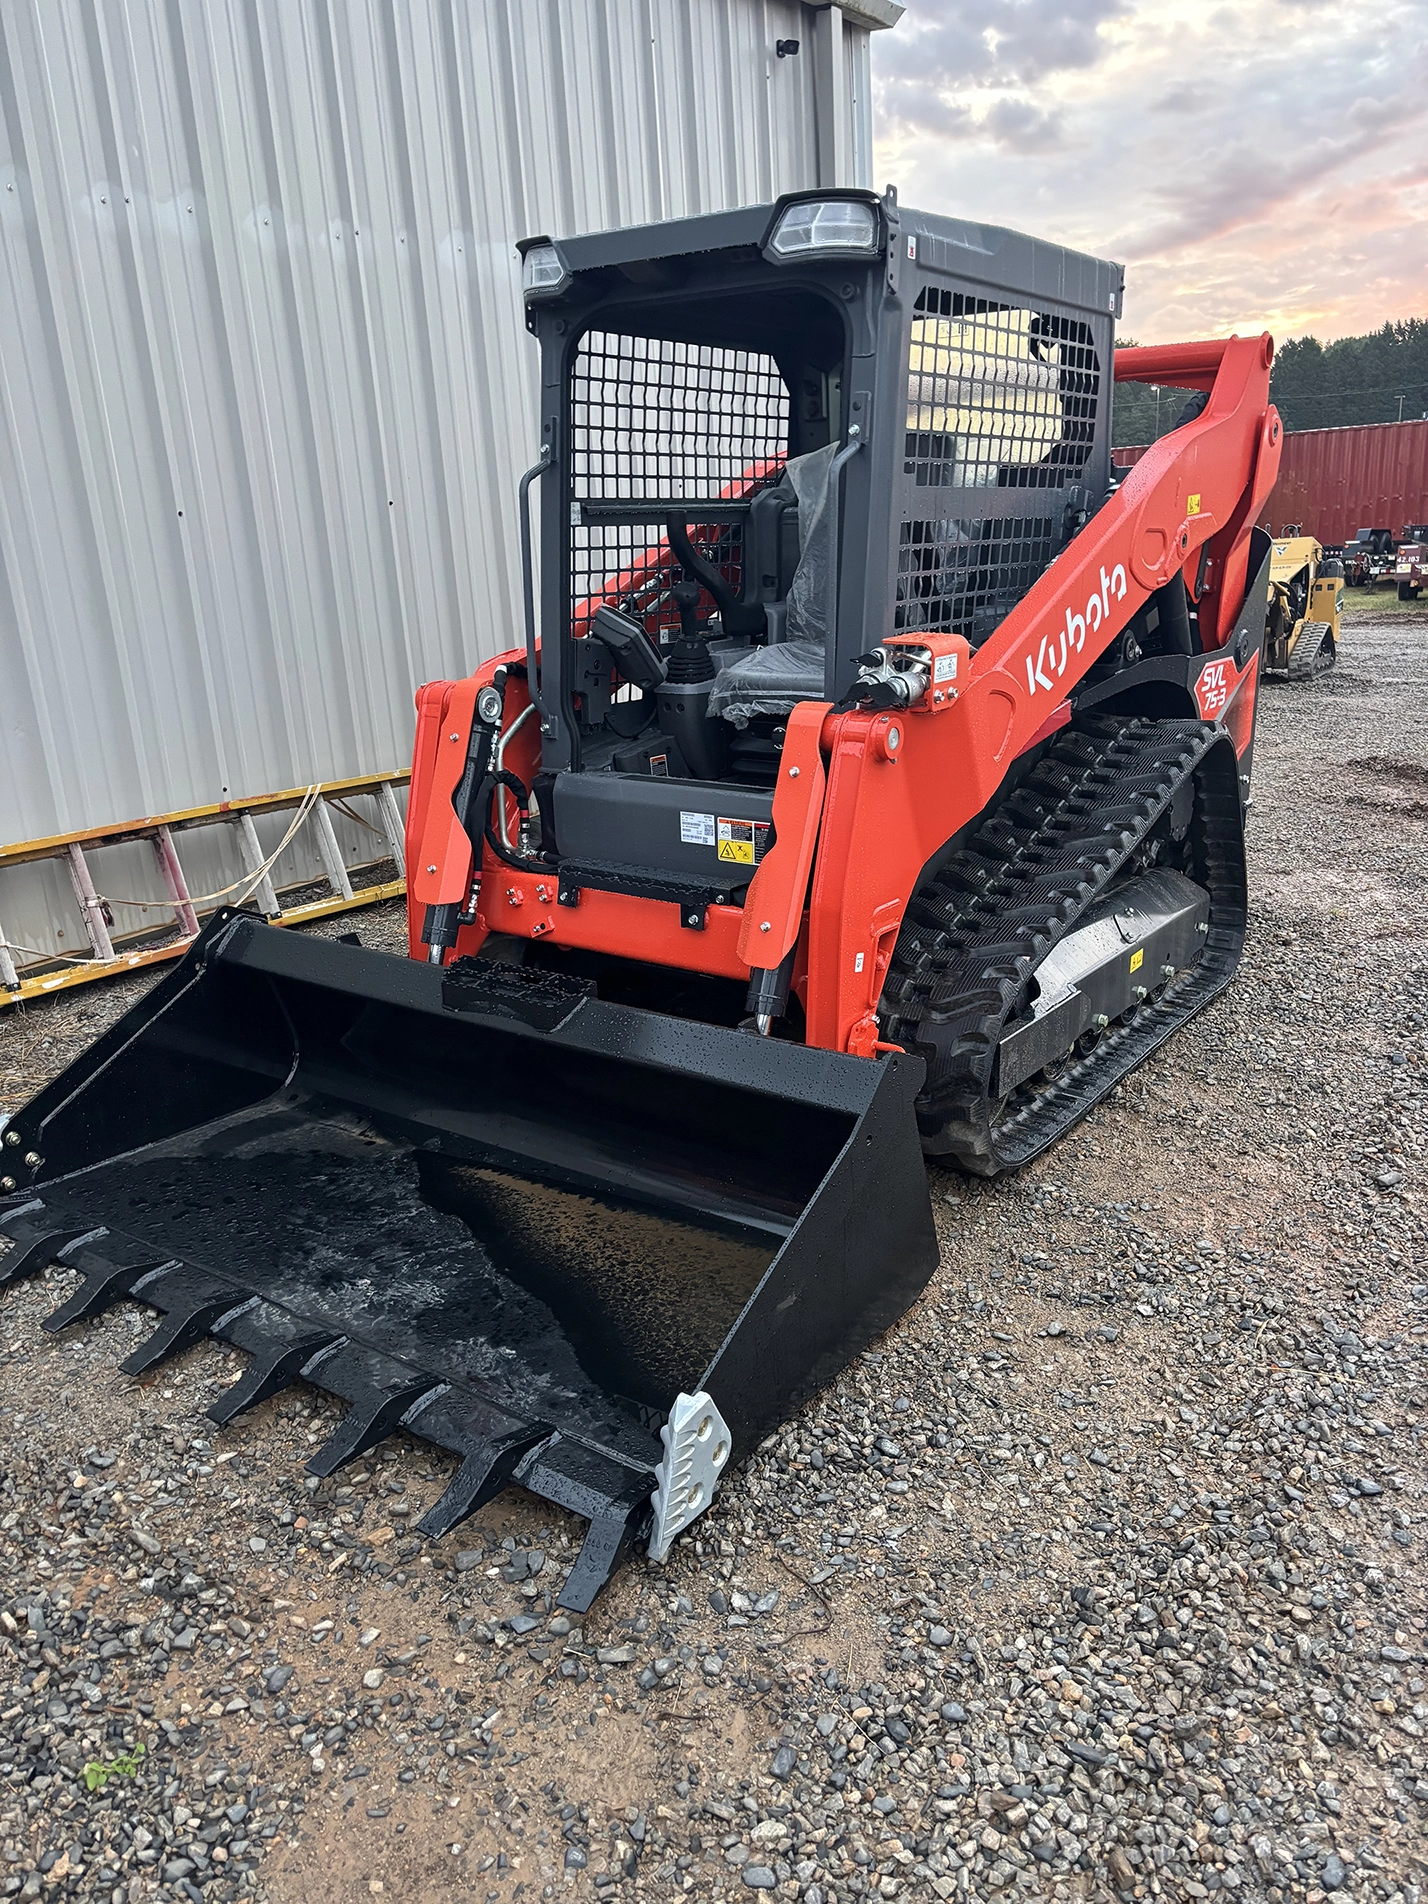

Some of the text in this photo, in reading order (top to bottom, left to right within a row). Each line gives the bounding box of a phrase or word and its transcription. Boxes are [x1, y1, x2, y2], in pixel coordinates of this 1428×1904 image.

[1025, 563, 1127, 696] Kubota
[1201, 664, 1226, 692] SVL
[1203, 687, 1227, 711] 75-3
